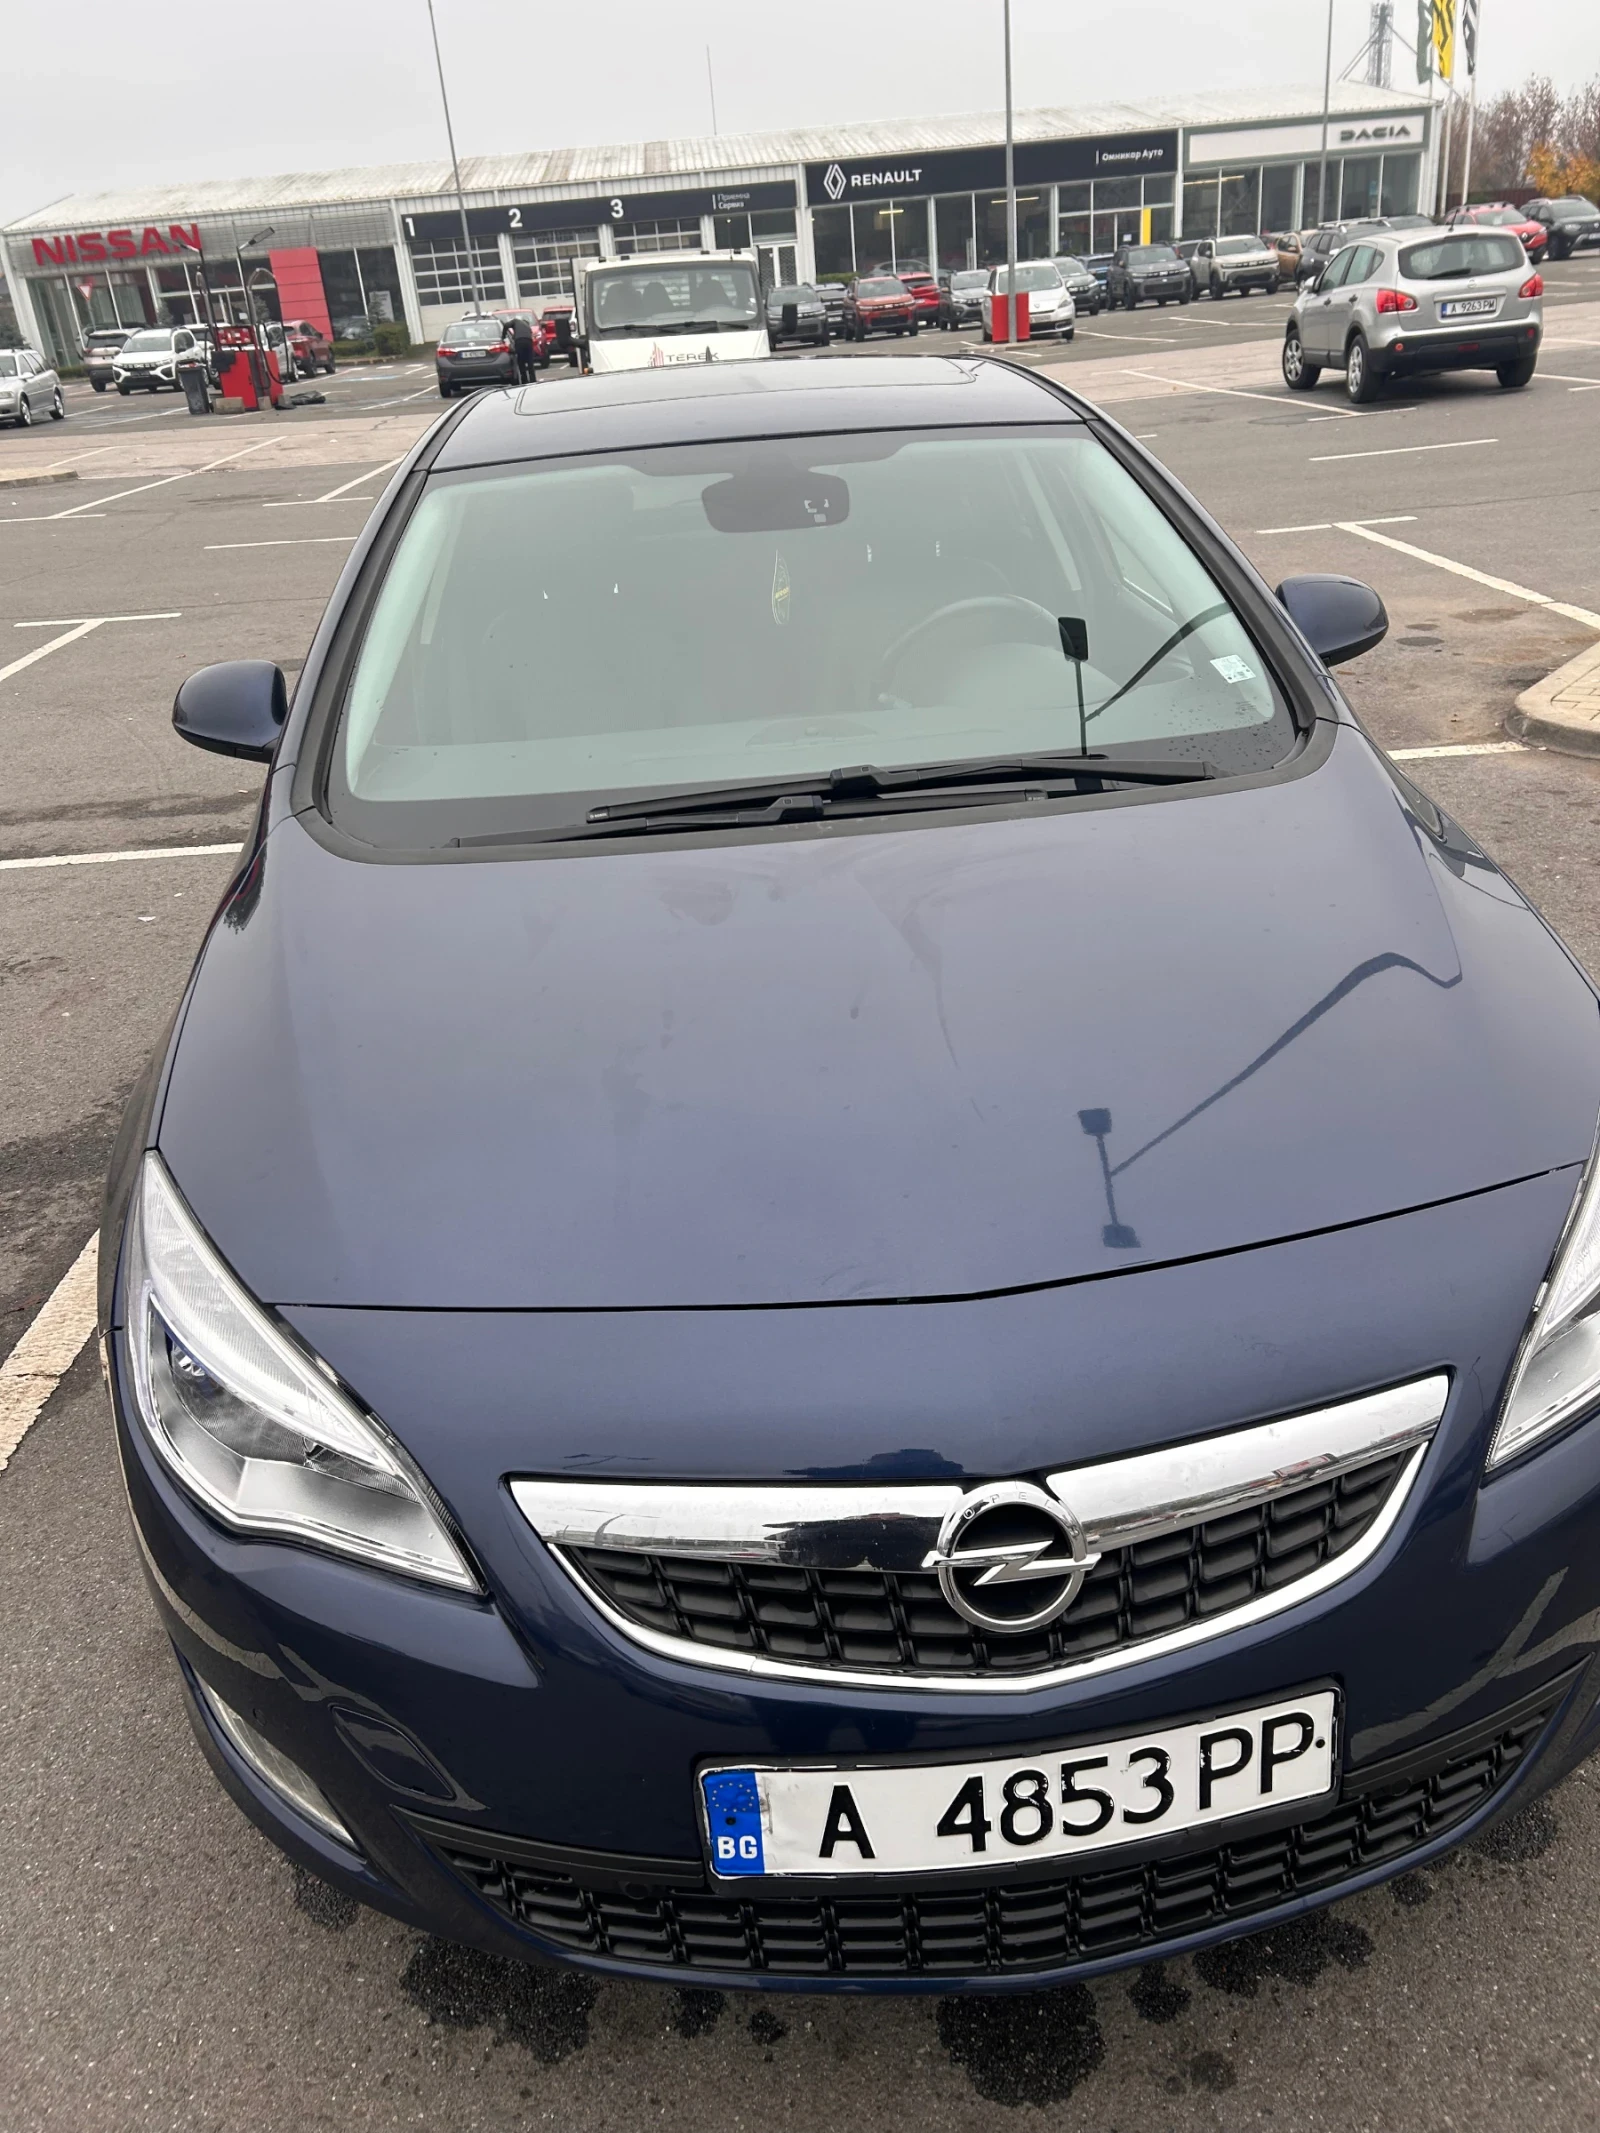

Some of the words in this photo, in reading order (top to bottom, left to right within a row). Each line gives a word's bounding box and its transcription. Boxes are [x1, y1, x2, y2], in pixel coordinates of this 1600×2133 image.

[1340, 125, 1411, 141] DACIA
[1142, 149, 1164, 159] Ауто
[851, 169, 922, 187] RENAULT
[508, 208, 523, 228] 2
[610, 199, 624, 218] 3
[405, 217, 416, 237] 1
[31, 223, 202, 266] NISSAN
[1451, 304, 1457, 313] A
[818, 1784, 876, 1859] A
[936, 1746, 1176, 1853] 4853
[1199, 1711, 1315, 1810] PP
[717, 1835, 758, 1859] BG
